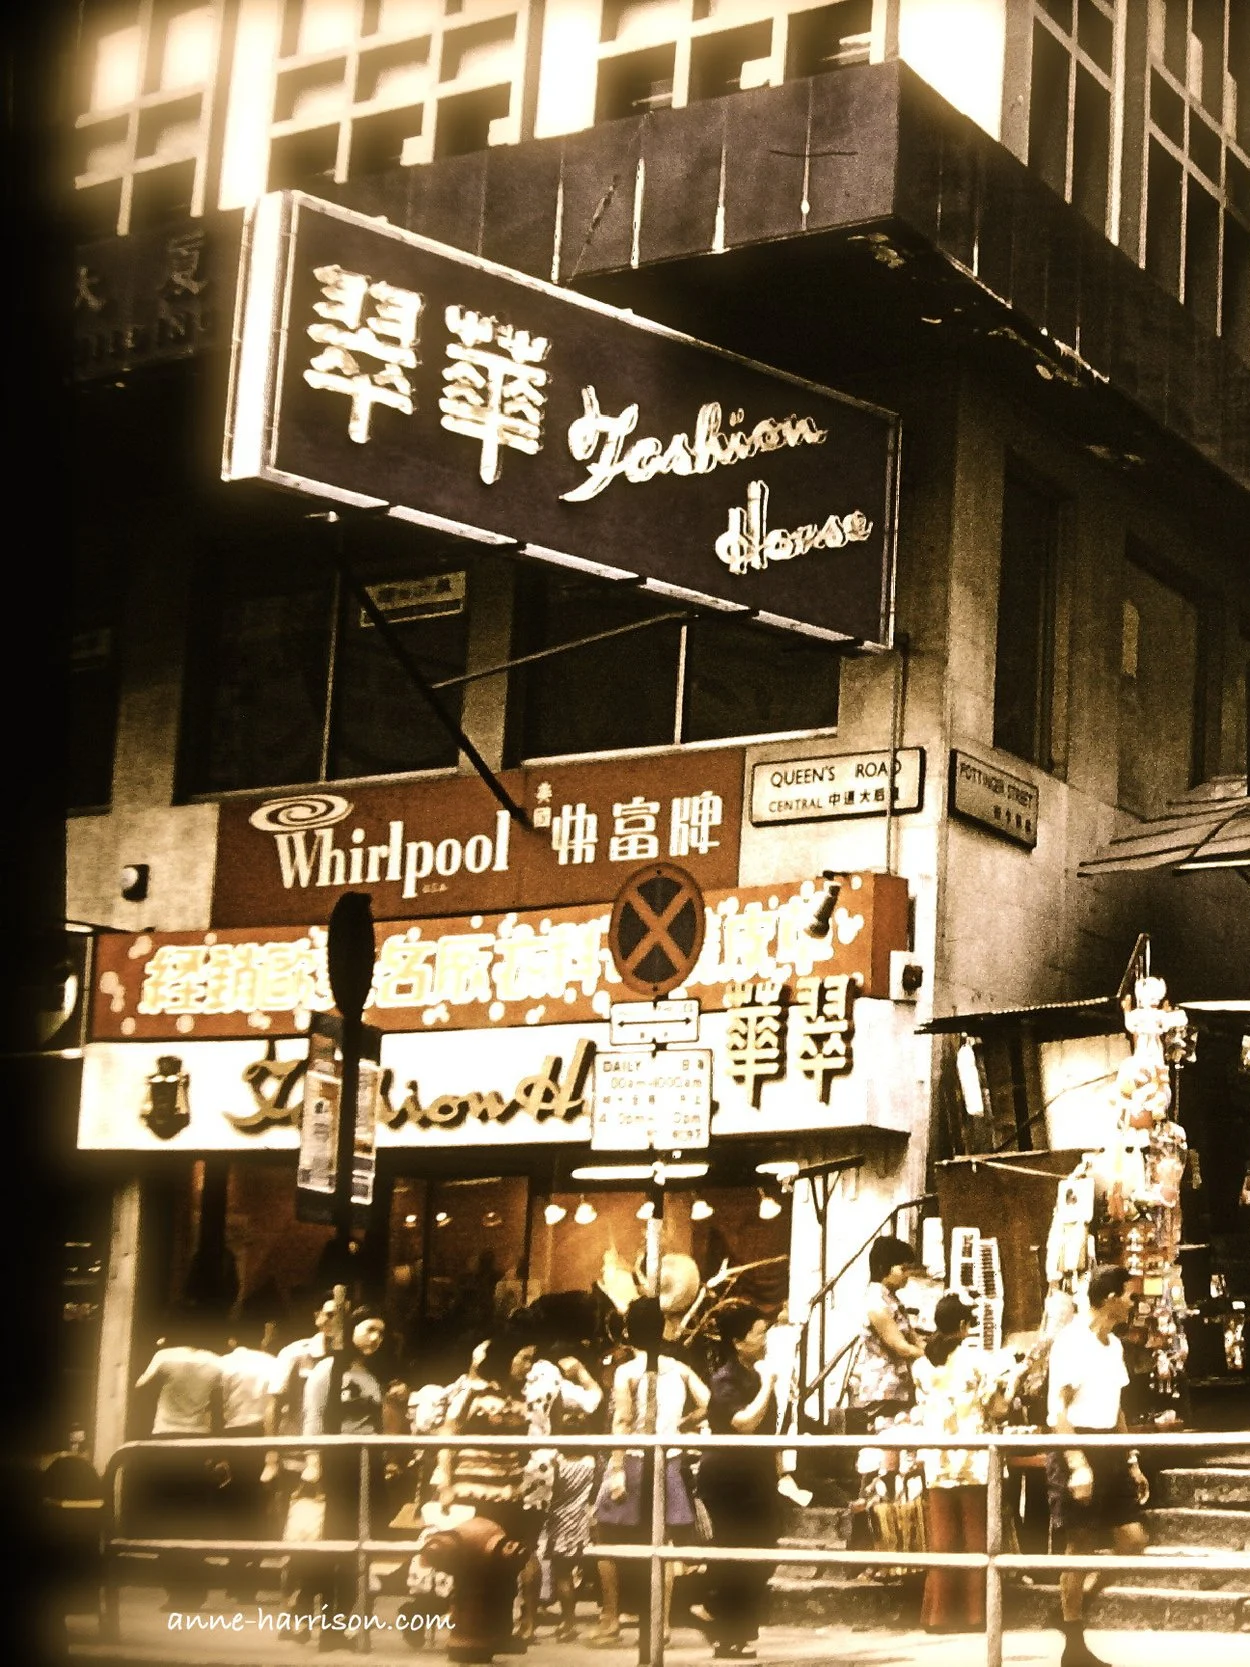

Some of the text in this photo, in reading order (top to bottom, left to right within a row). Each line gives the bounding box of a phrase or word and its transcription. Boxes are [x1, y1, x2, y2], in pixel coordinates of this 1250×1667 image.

[558, 386, 828, 502] Fashion
[715, 481, 873, 575] House
[770, 765, 836, 788] QUEEN'S
[768, 797, 823, 814] CENTRAL
[274, 809, 510, 899] Whirlpool
[603, 1060, 642, 1074] DAILY
